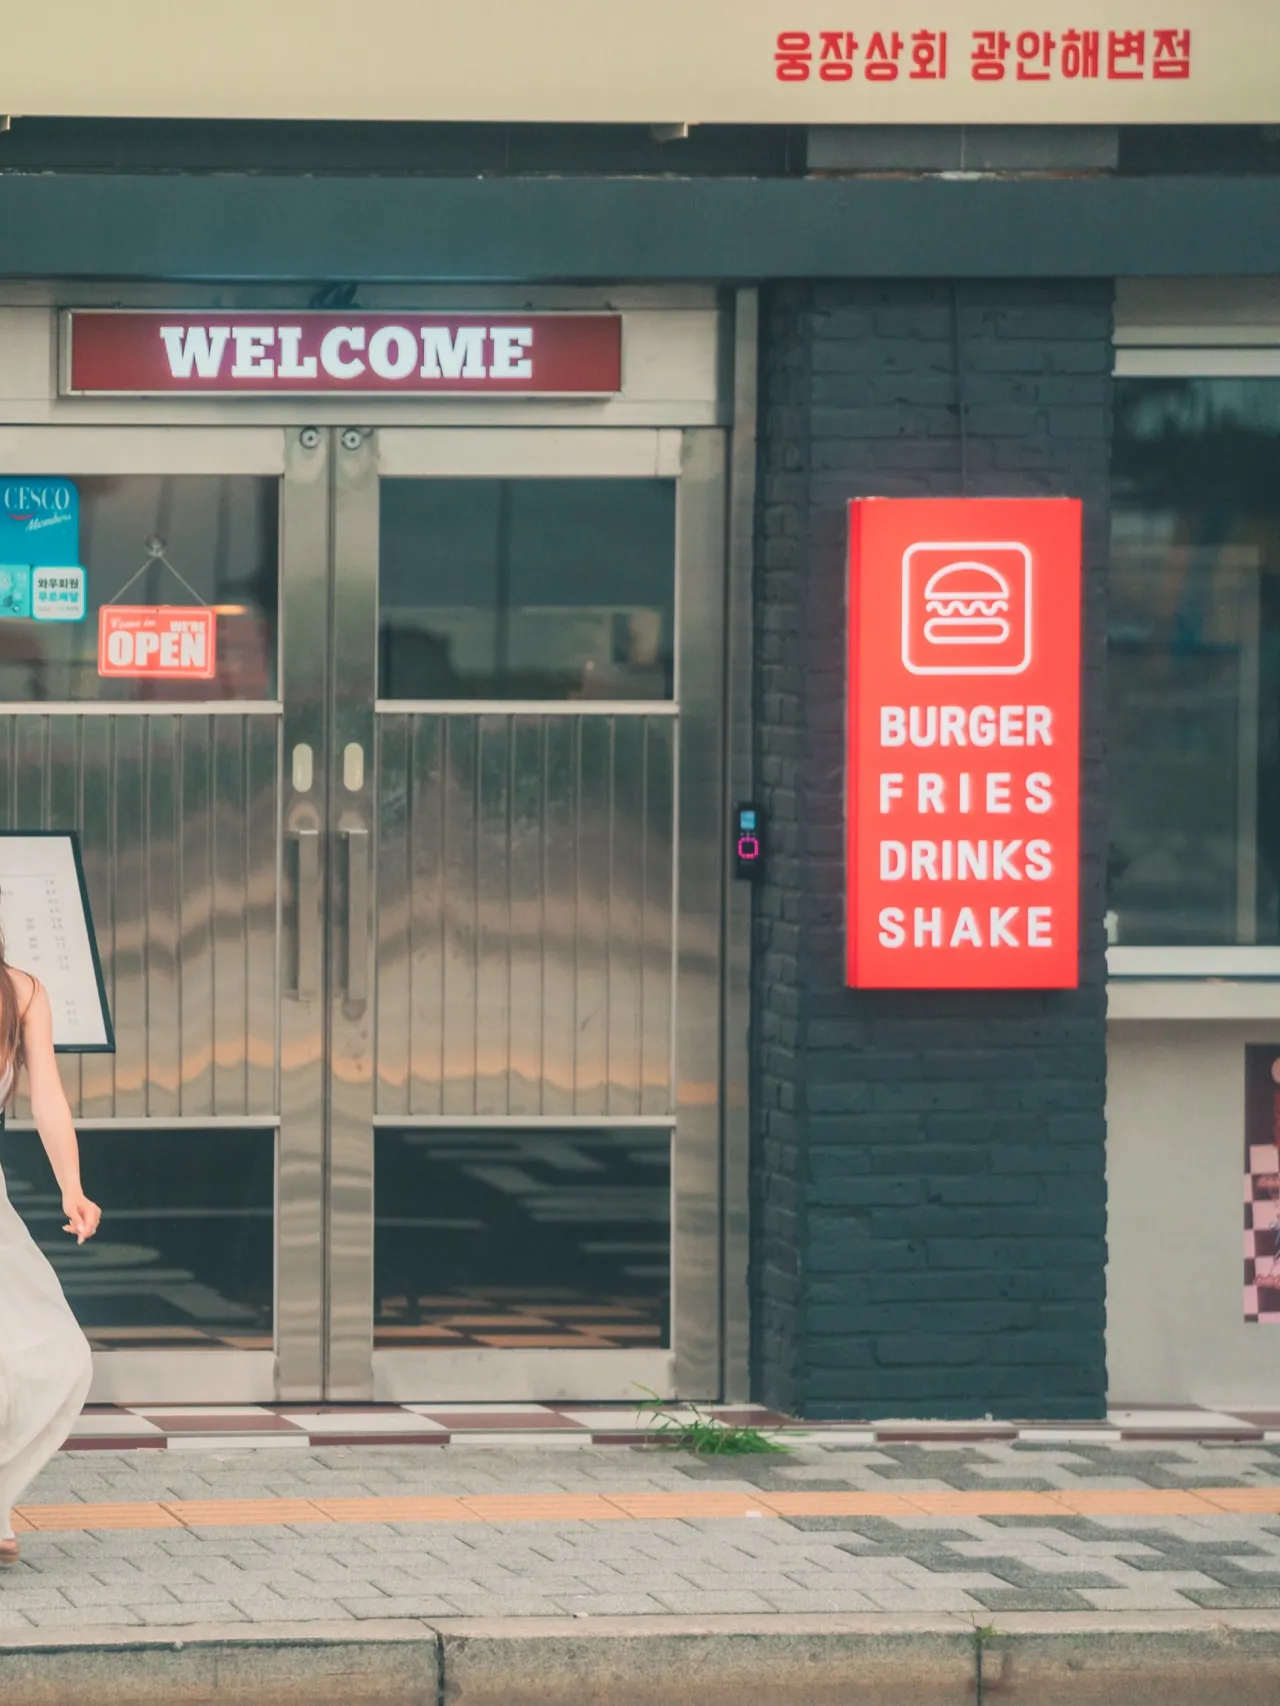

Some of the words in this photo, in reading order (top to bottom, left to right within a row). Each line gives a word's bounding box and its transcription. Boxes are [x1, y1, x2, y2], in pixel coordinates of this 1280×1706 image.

[773, 29, 948, 83] 웅장상회
[970, 28, 1191, 82] 광안해변점
[160, 325, 533, 380] WELCOME
[4, 485, 70, 511] CESCO
[25, 512, 72, 532] Members
[107, 630, 206, 668] OPEN
[879, 705, 1054, 747] BURGER
[879, 772, 1054, 814] FRIES
[879, 839, 1054, 881] DRINKS
[878, 905, 1054, 948] SHAKE
